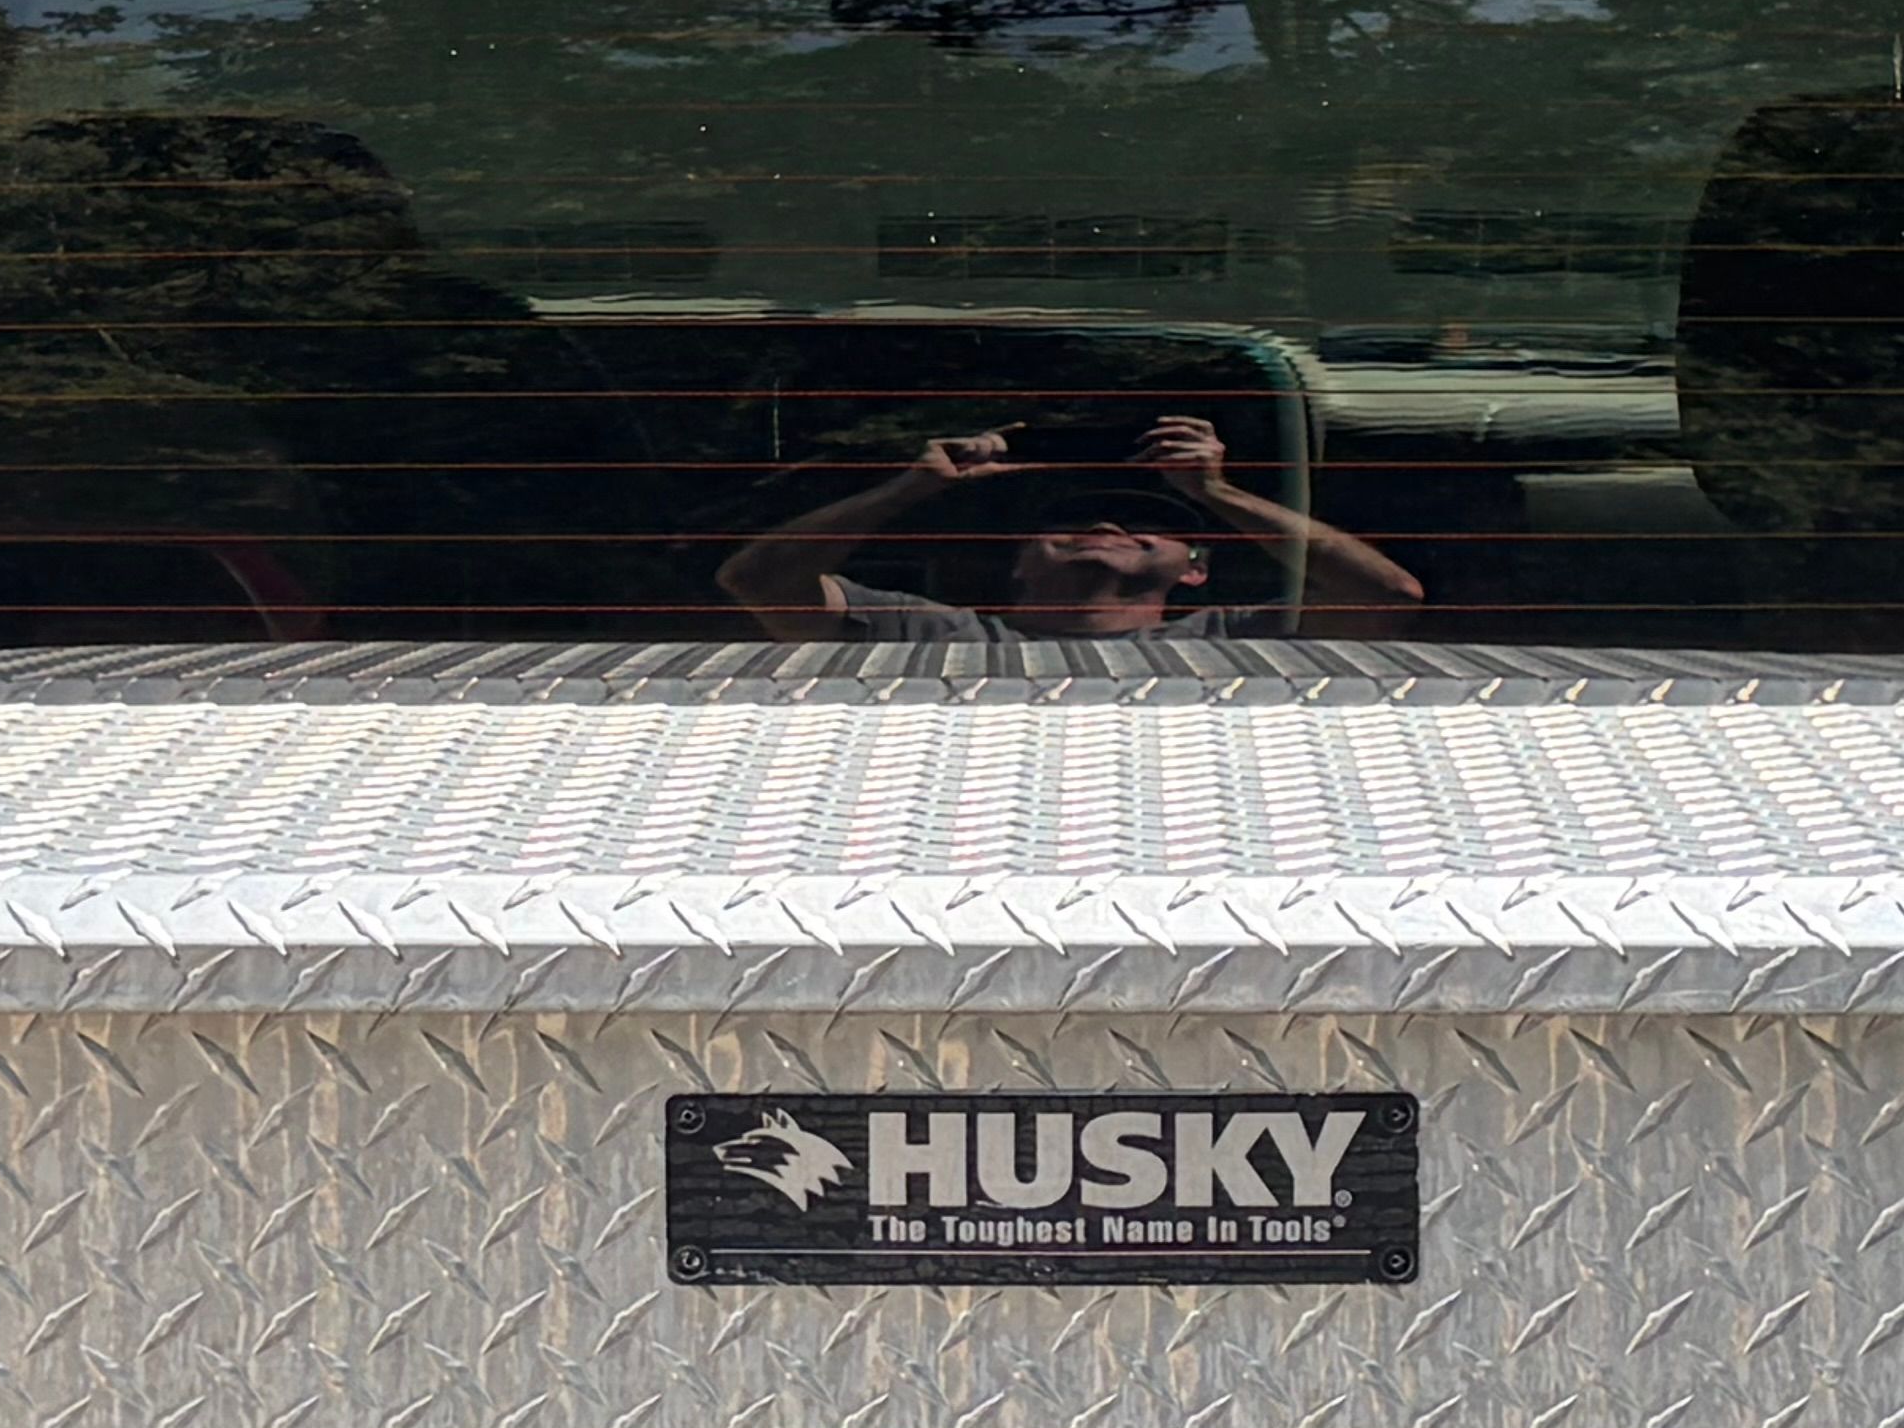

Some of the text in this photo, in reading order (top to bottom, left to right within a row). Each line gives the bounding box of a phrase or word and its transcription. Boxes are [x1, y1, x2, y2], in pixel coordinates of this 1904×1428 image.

[866, 1214, 927, 1243] The
[940, 1214, 1087, 1247] Toughest
[1102, 1215, 1194, 1244] Name
[1206, 1215, 1238, 1243] In
